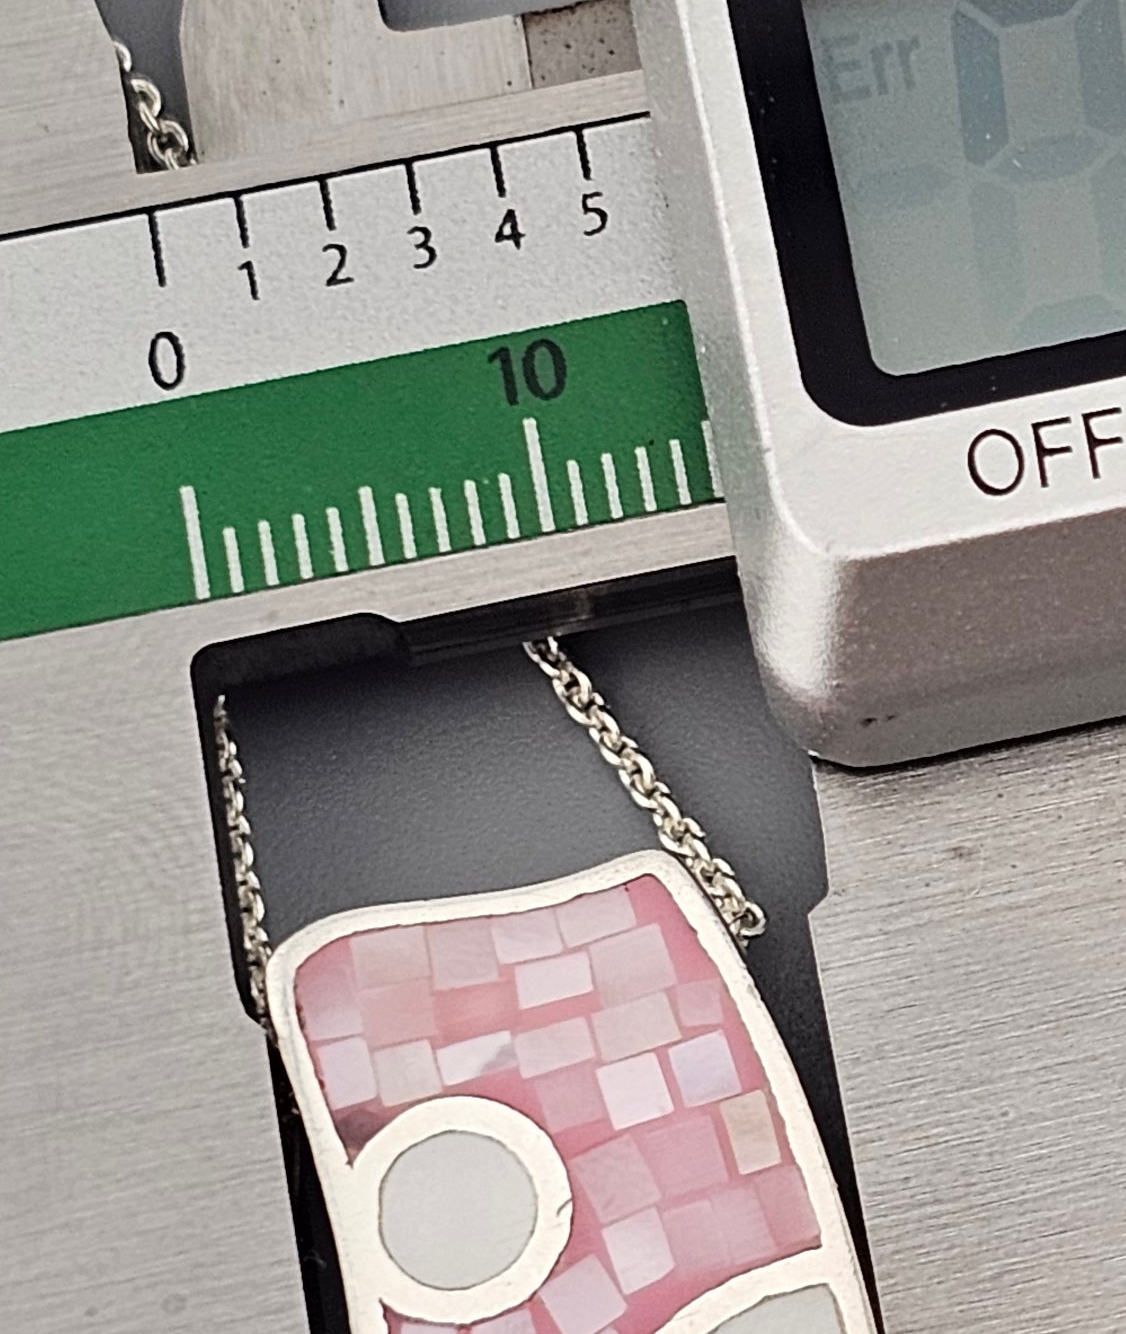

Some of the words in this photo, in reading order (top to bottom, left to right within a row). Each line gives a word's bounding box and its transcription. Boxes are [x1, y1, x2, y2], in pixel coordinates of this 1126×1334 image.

[237, 260, 260, 301] 1
[322, 243, 354, 287] 2
[408, 225, 438, 270] 3
[494, 208, 525, 250] 4
[580, 193, 608, 236] 5
[148, 331, 186, 391] 0
[488, 338, 568, 406] 10
[966, 406, 1124, 497] OFF
